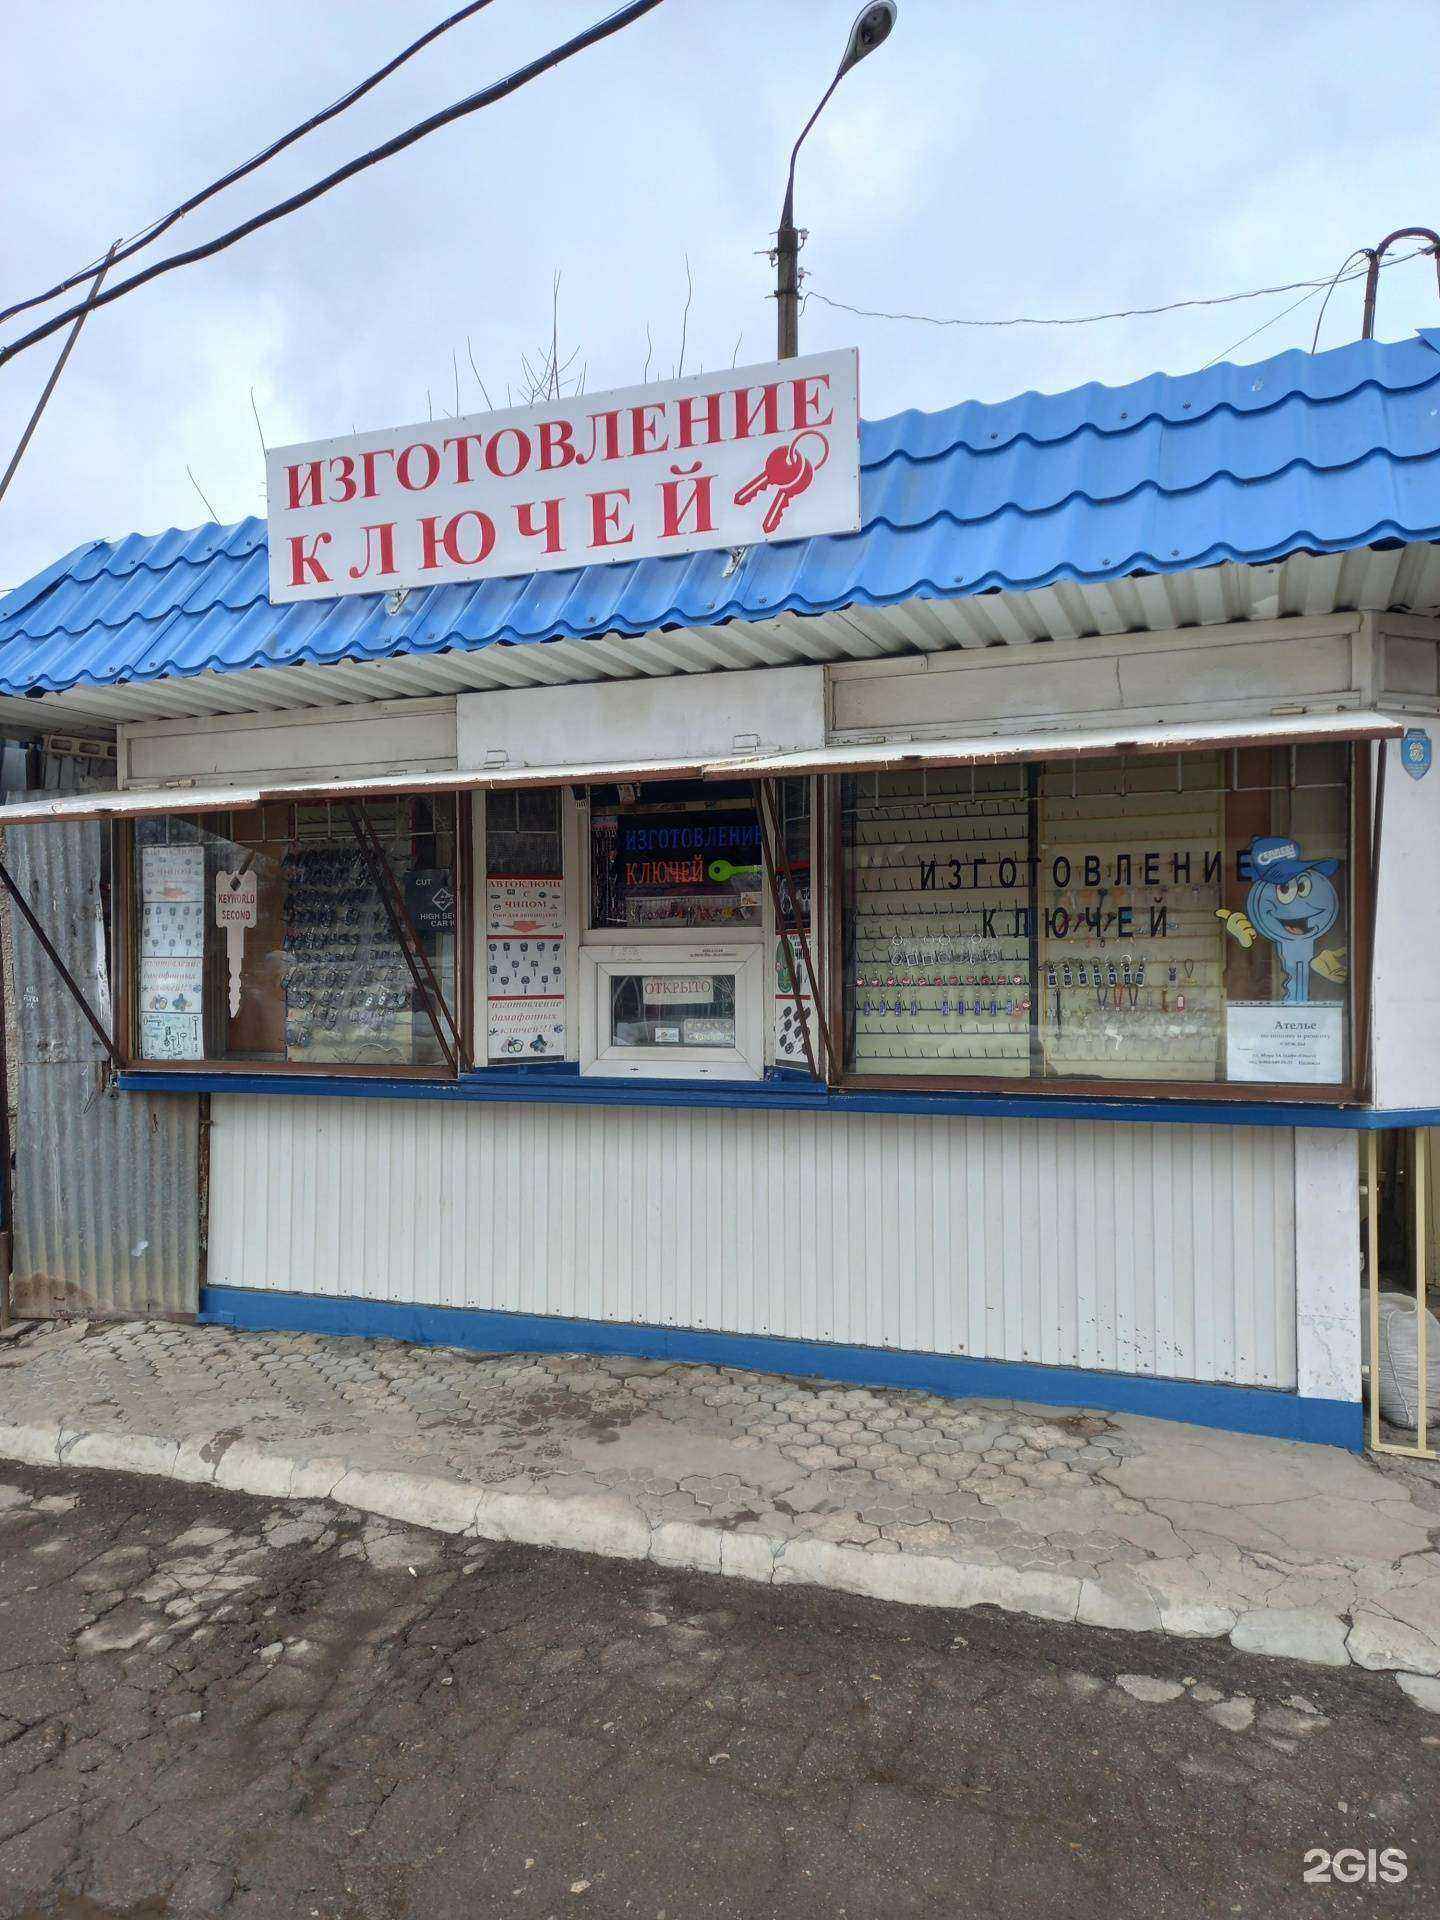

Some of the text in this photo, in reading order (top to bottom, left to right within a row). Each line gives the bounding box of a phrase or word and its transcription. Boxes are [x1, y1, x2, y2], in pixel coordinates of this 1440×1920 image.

[283, 374, 833, 510] ИЗГОТОВЛЕНИЕ
[287, 461, 719, 586] КЛЮЧЕЙ
[625, 854, 704, 885] КЛЮЧЕЙ
[920, 851, 1252, 890] ИЗГОТОВЛЕНИЕ
[222, 910, 251, 920] SECOND
[982, 896, 1168, 939] КЛЮЧЕЙ
[644, 981, 711, 994] ОТКРЫТО
[1275, 1021, 1317, 1030] Ателье
